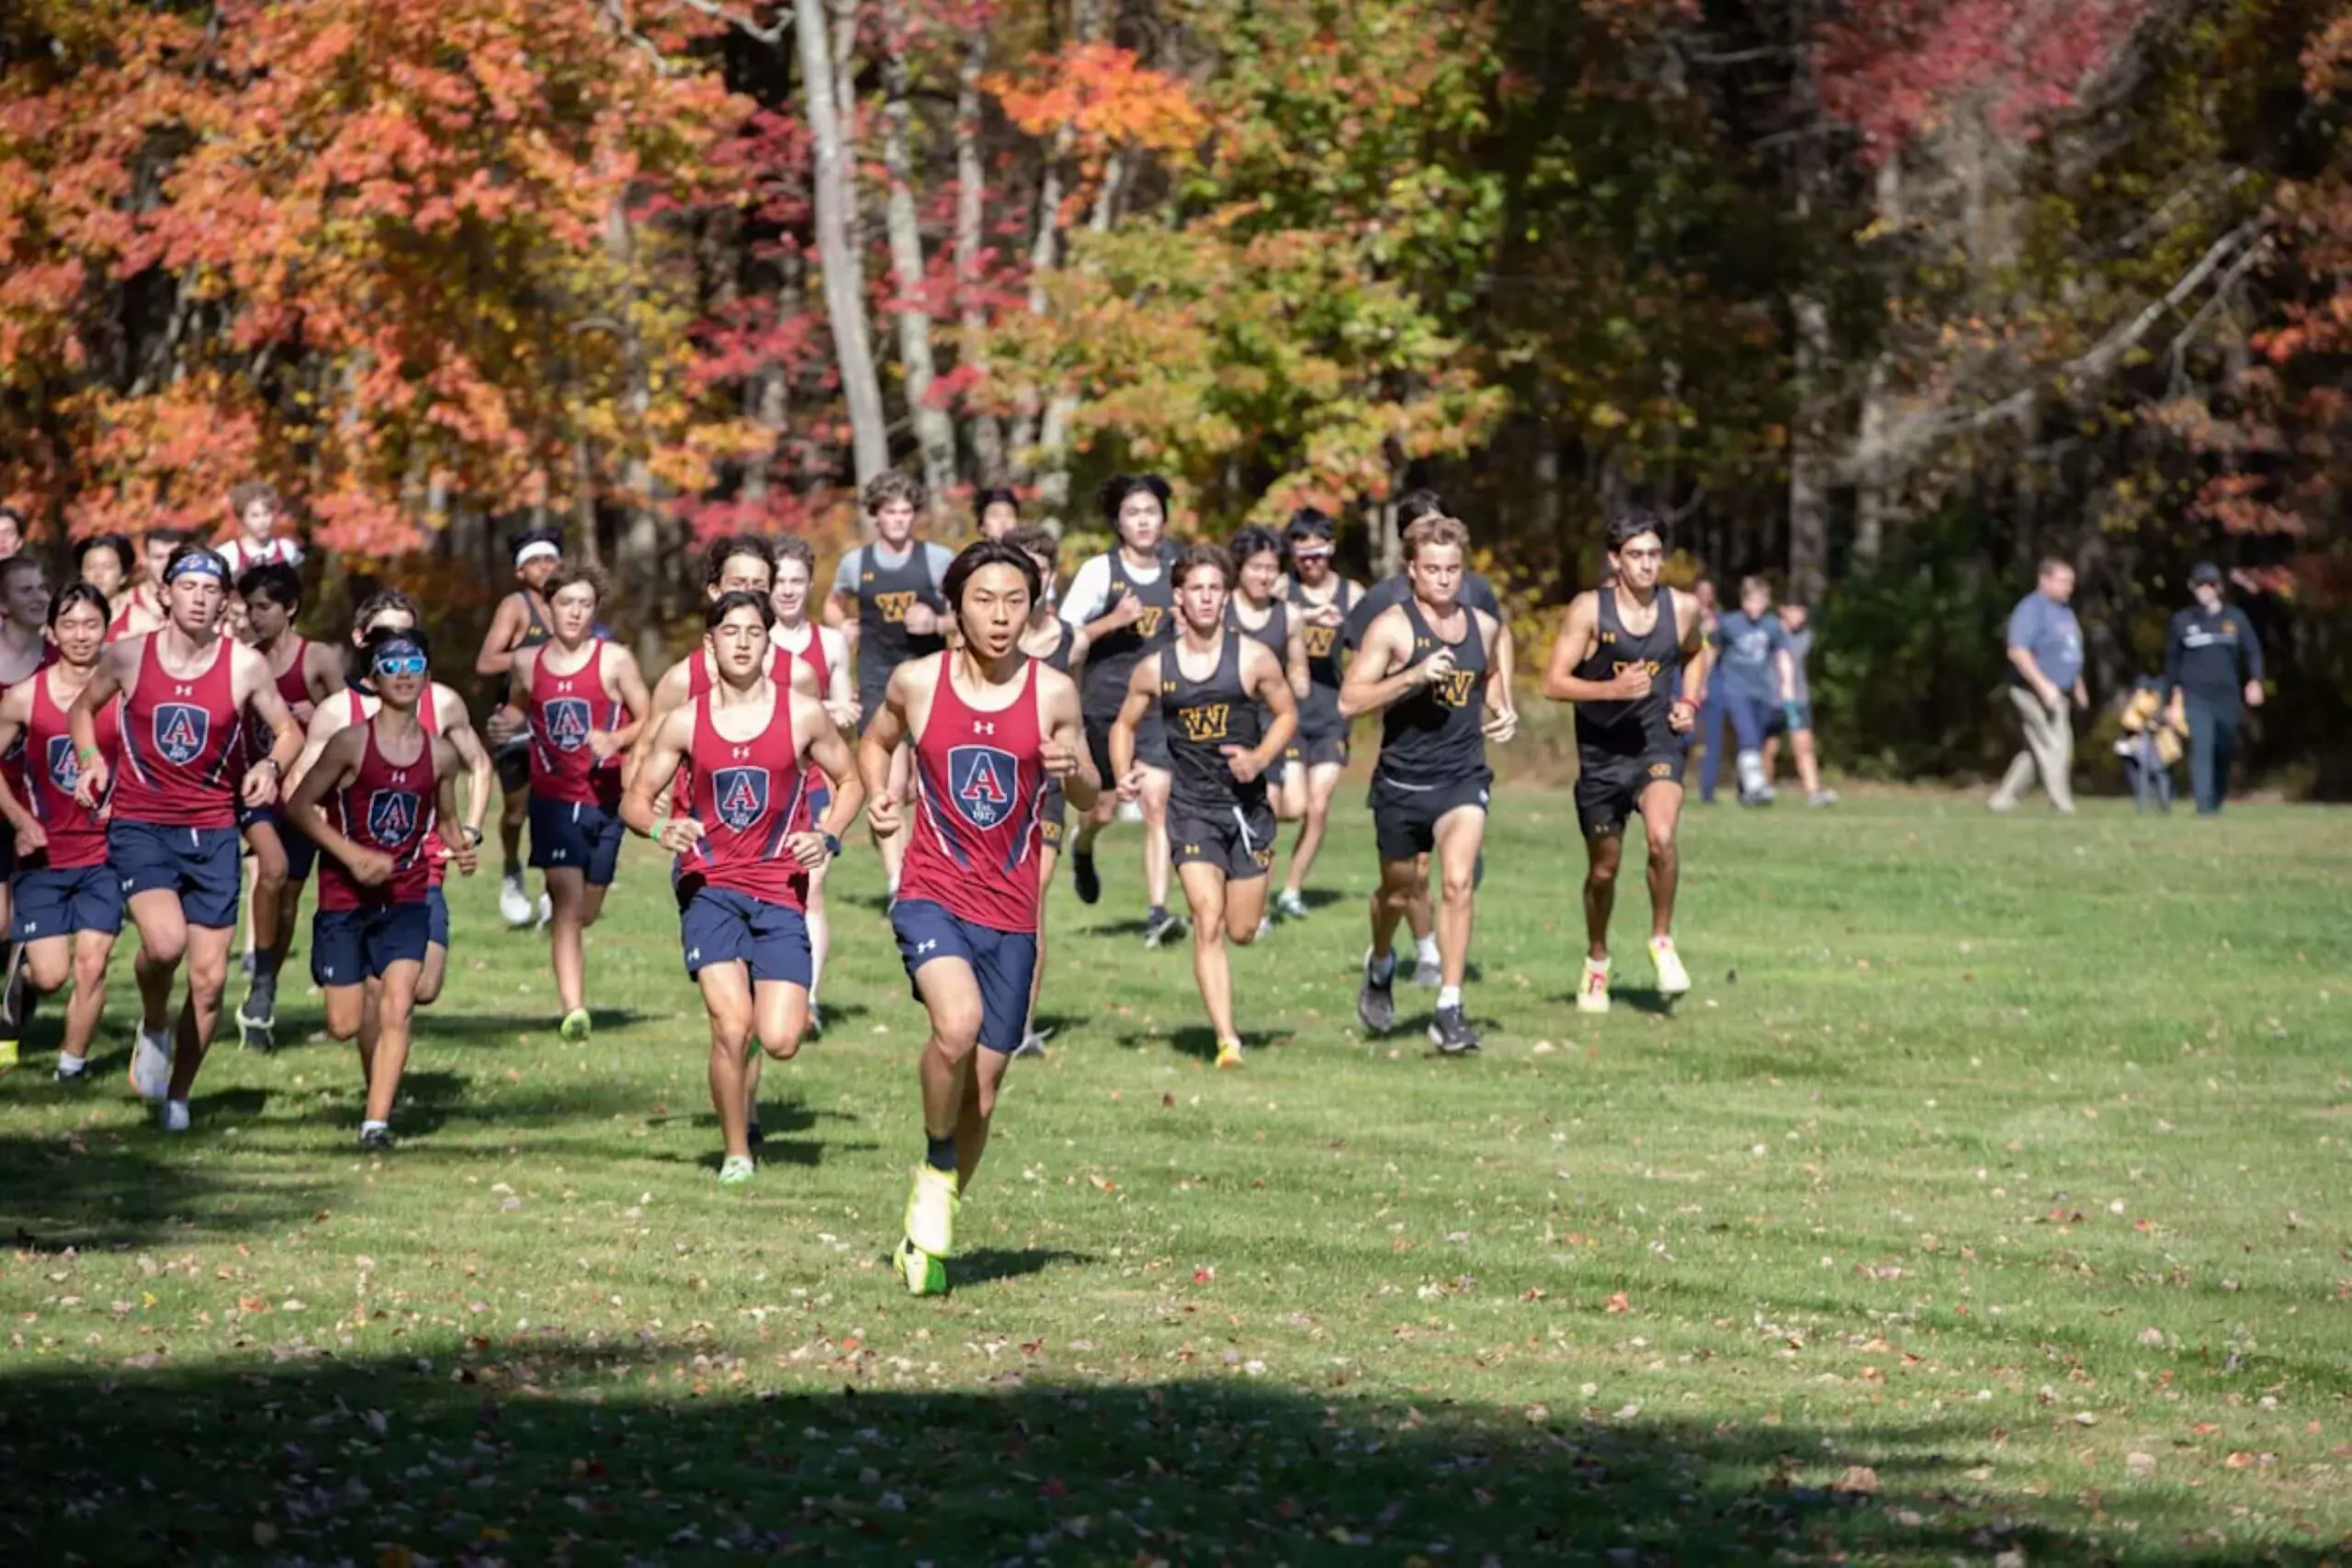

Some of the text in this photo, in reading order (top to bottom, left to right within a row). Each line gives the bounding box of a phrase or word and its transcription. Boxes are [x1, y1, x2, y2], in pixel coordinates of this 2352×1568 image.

[161, 707, 199, 746] A
[550, 701, 586, 736] A
[1179, 704, 1229, 741] W
[722, 771, 759, 810] A
[960, 751, 1008, 804] A
[375, 792, 410, 829] A
